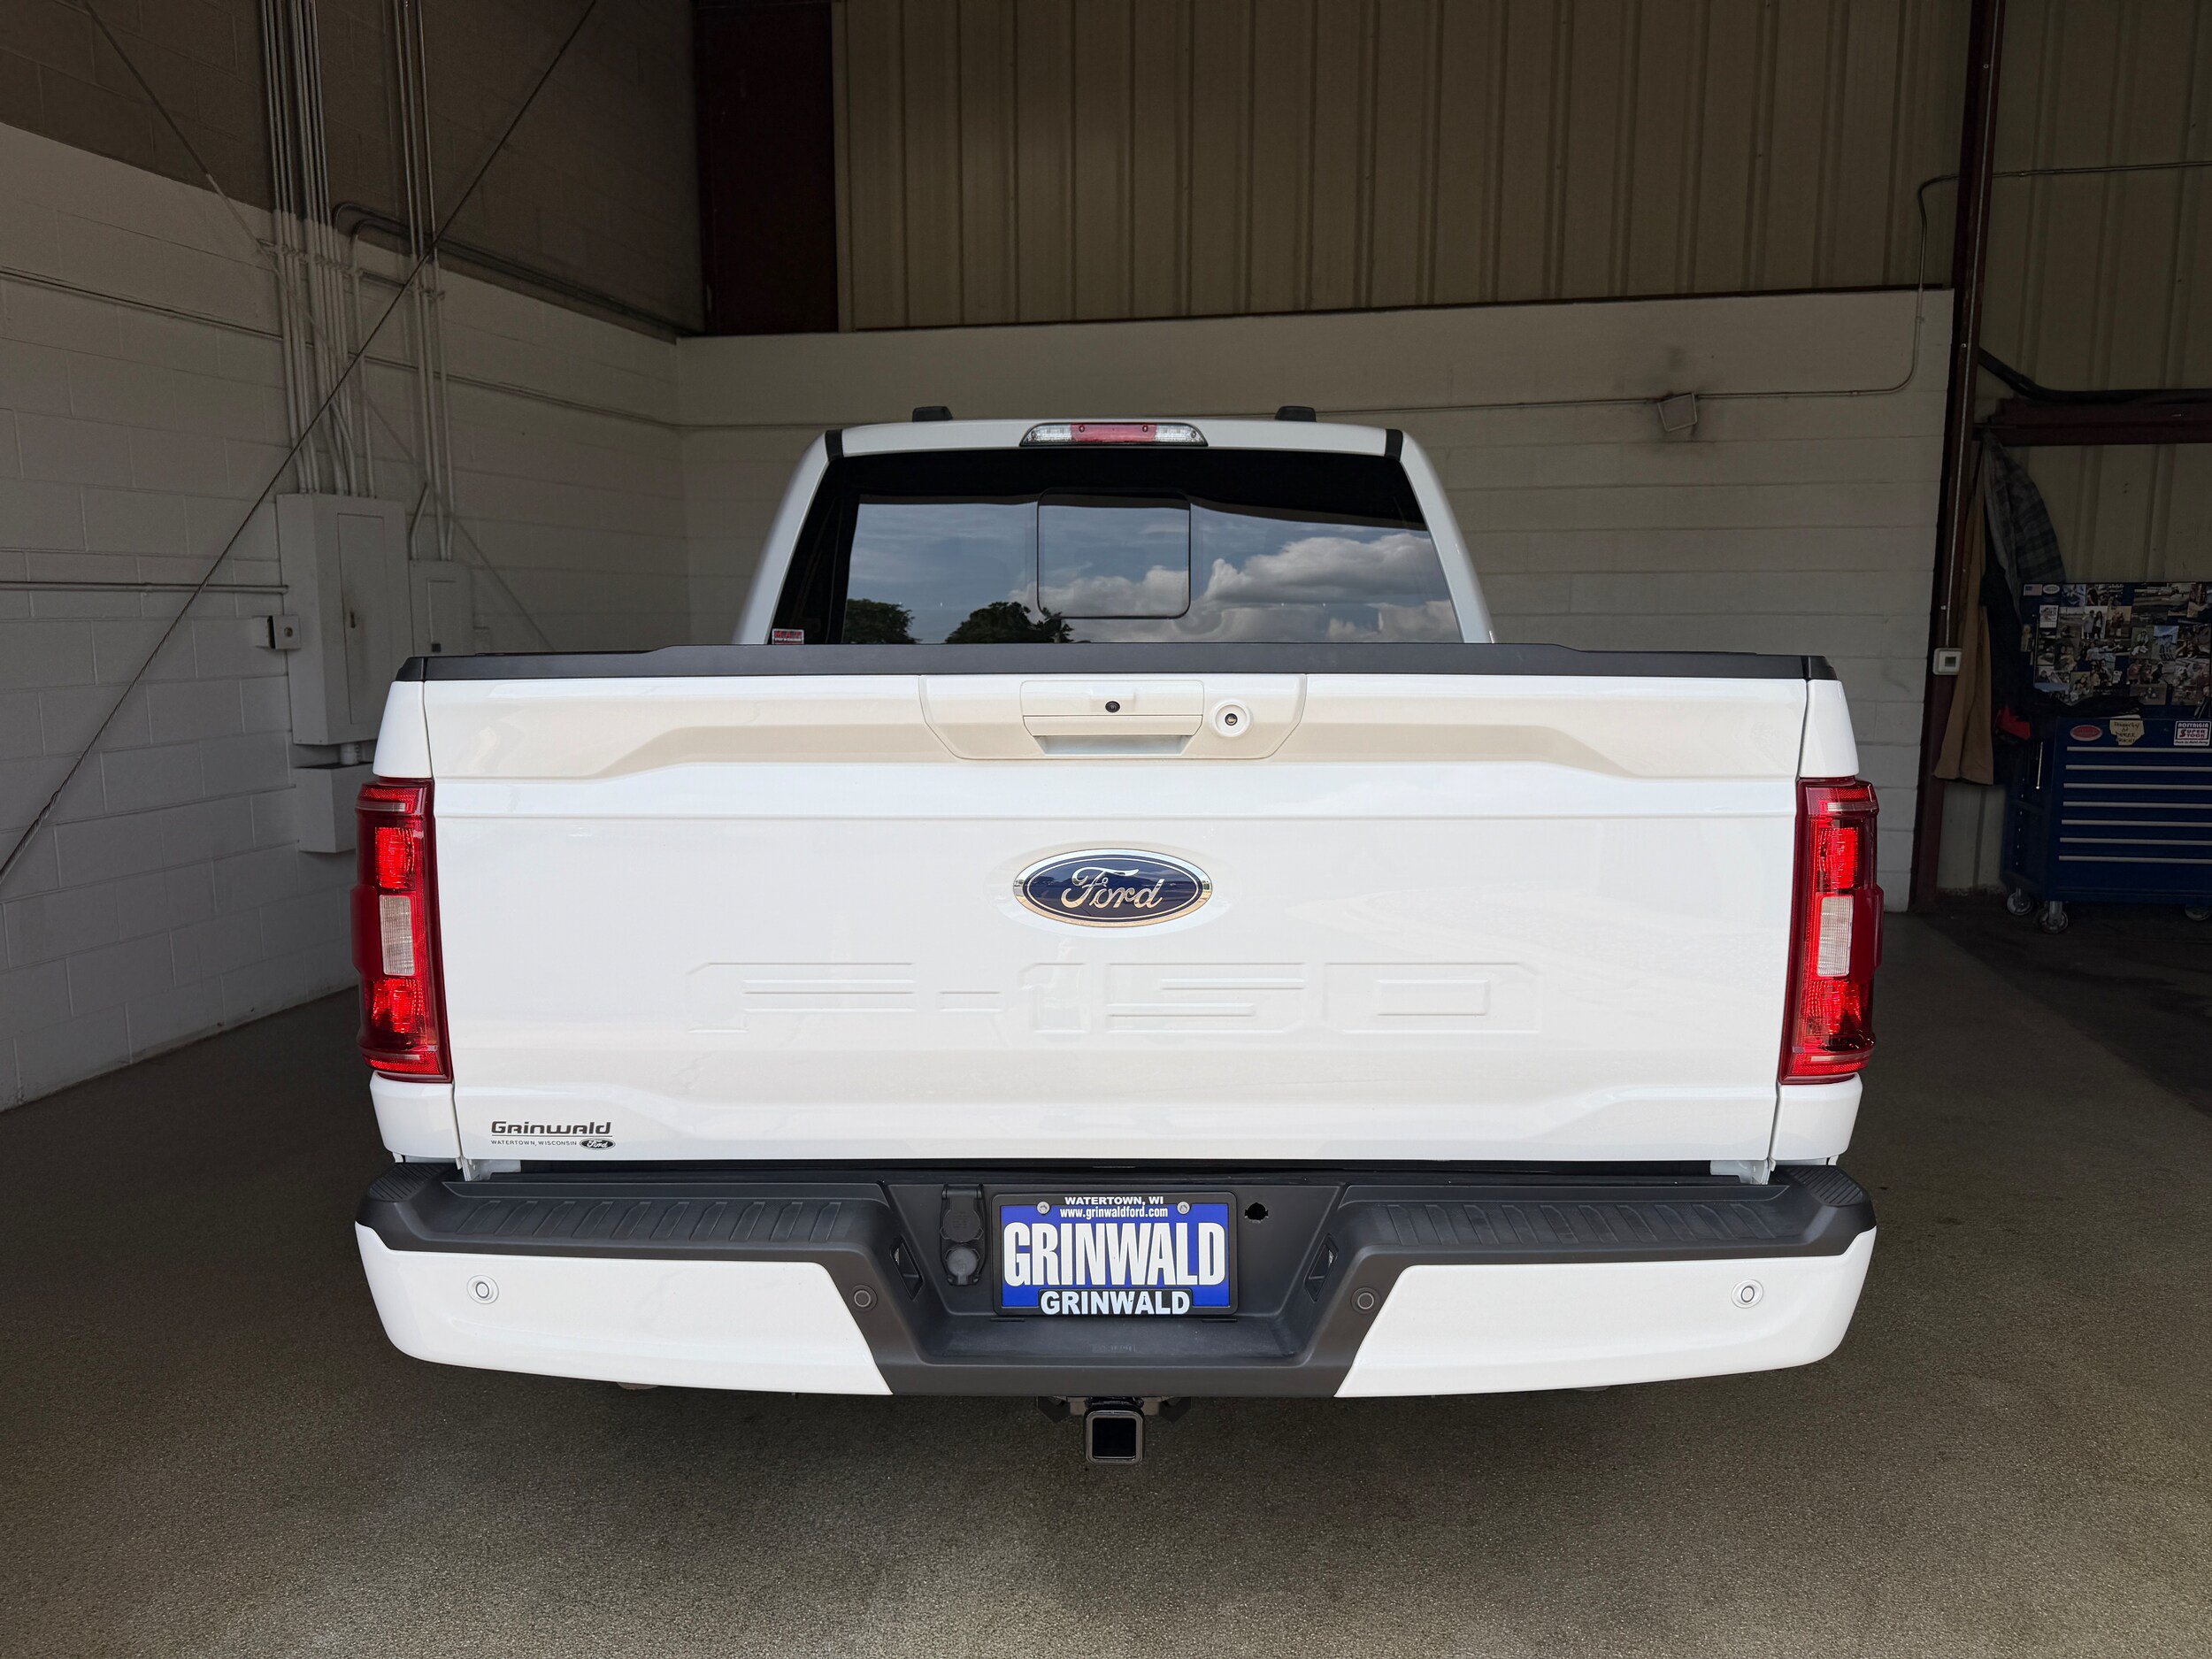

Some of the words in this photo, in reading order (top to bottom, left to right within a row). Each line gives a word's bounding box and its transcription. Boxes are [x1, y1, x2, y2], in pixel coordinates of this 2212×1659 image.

[1061, 866, 1164, 909] Ford
[687, 963, 1547, 1035] F-150
[491, 1121, 611, 1133] Grinwald
[586, 1139, 609, 1148] Ford
[1065, 1196, 1145, 1205] WATERTOWN,
[1148, 1196, 1164, 1205] WI
[1060, 1206, 1168, 1219] www.grinwaldford.com
[1003, 1222, 1225, 1286] GRINWALD
[1041, 1291, 1190, 1315] GRINWALD
